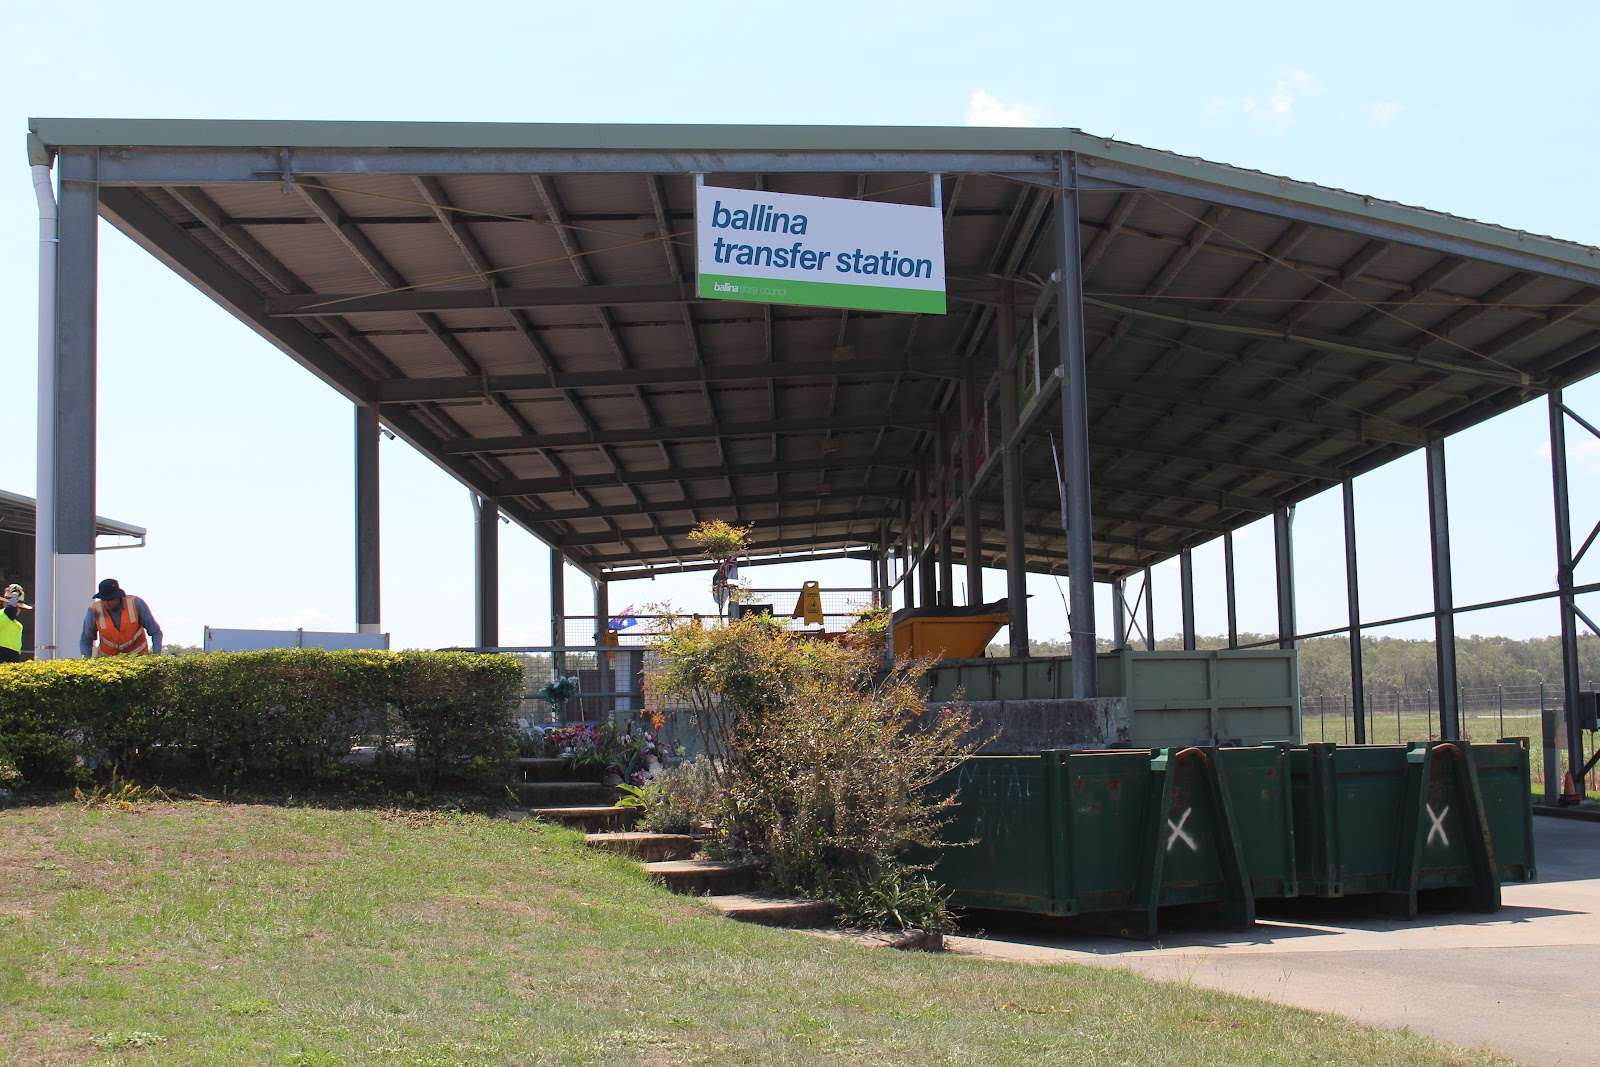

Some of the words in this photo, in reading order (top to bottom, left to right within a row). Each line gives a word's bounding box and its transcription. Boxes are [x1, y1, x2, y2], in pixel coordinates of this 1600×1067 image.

[711, 200, 808, 235] ballina
[713, 237, 830, 270] transfer
[835, 248, 932, 278] station
[713, 281, 739, 293] ballina
